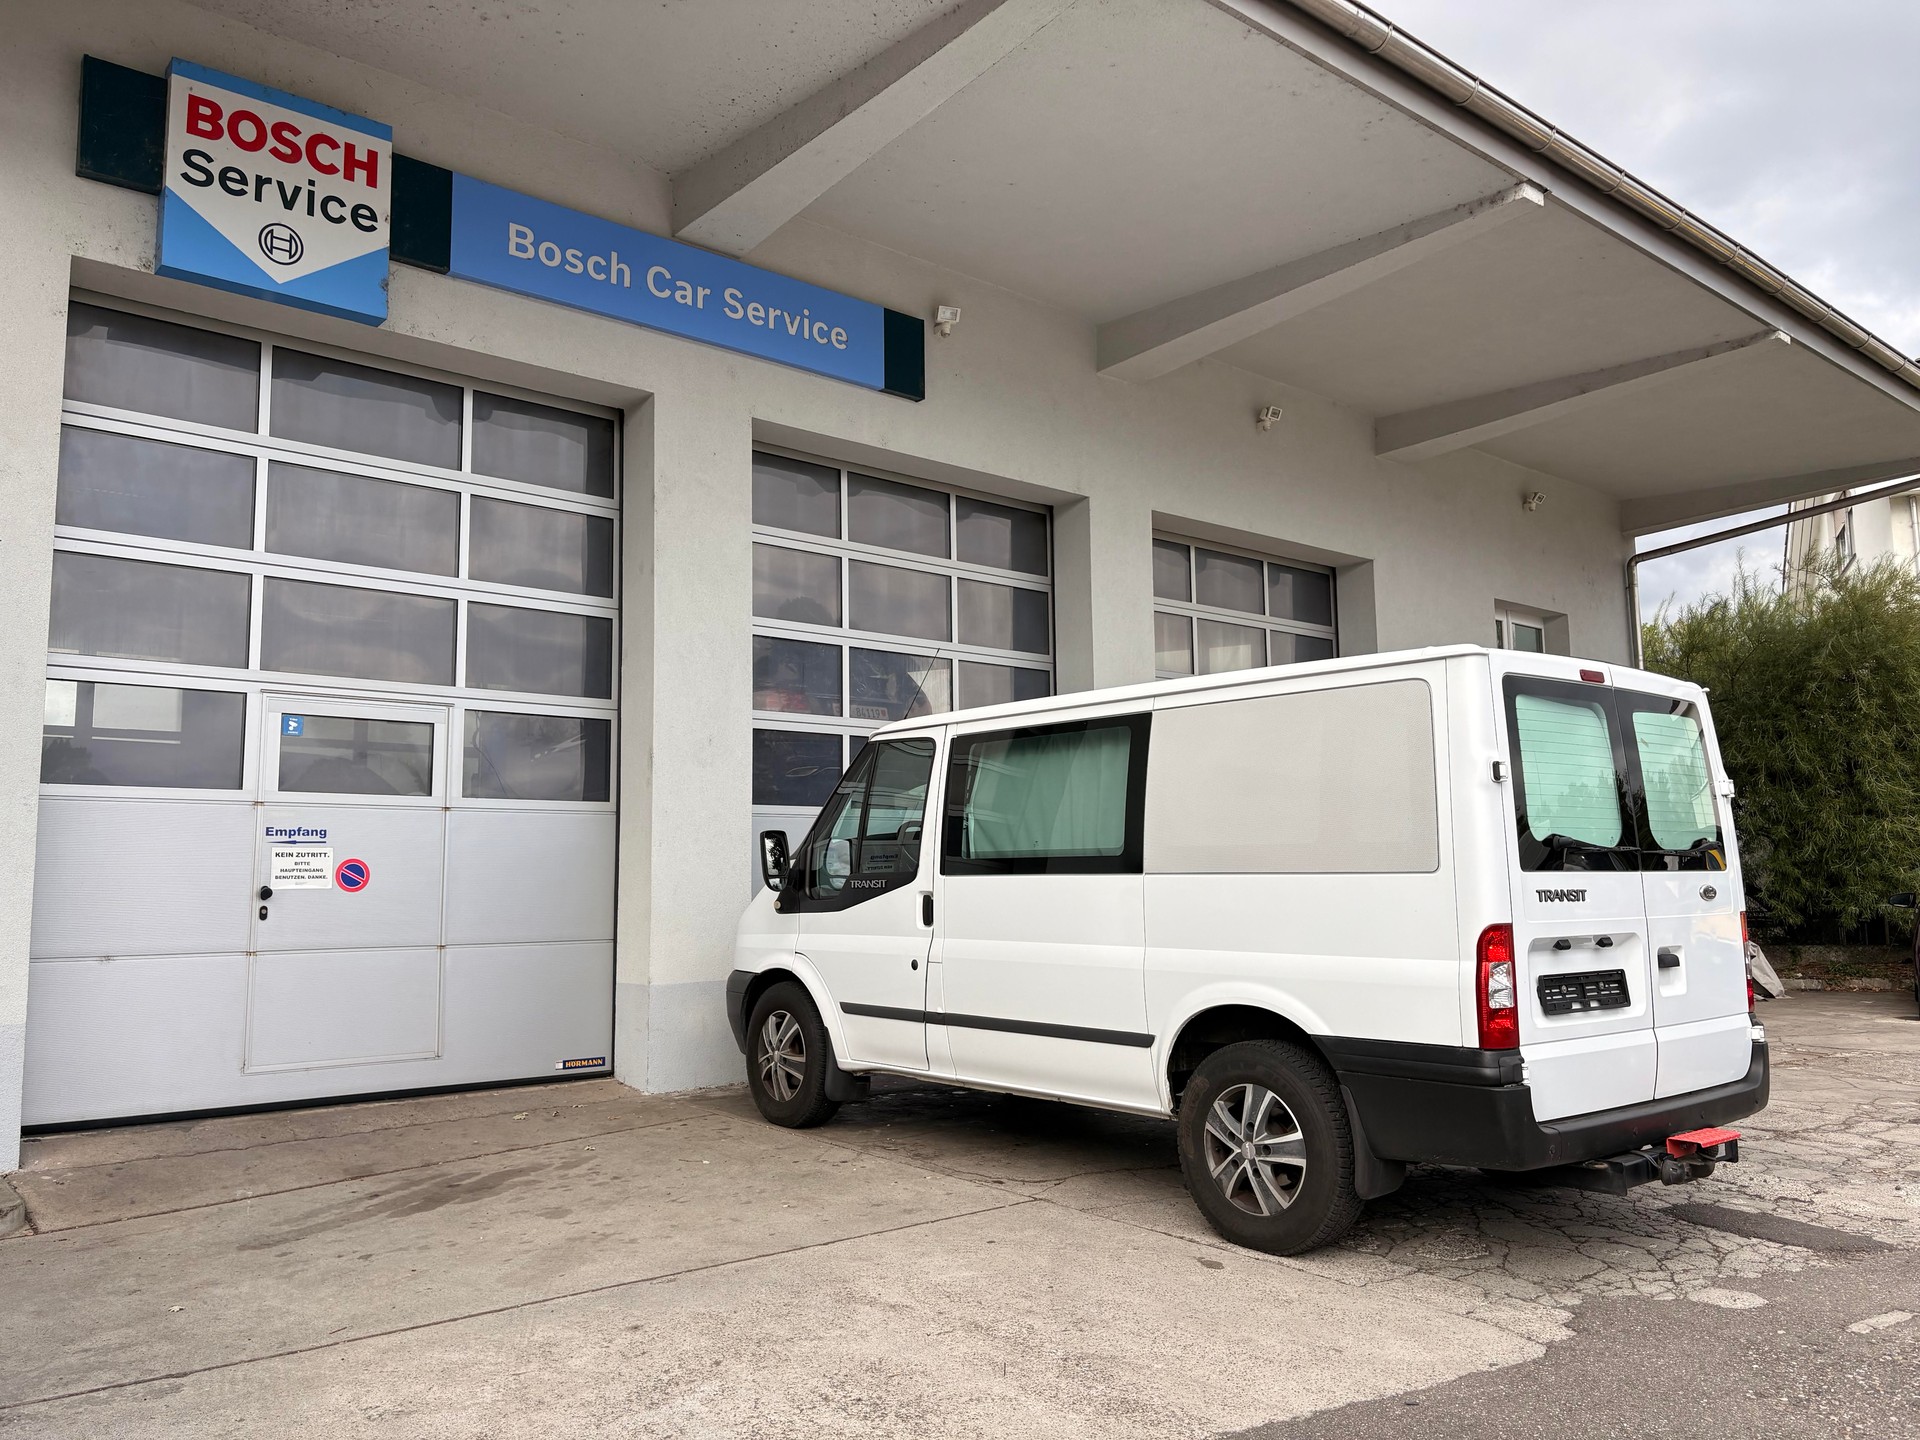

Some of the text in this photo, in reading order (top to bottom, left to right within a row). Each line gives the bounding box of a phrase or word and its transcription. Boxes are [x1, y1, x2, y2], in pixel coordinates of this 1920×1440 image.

[185, 93, 379, 189] BOSCH
[180, 148, 379, 233] Service
[508, 222, 849, 350] Bosch Car Service
[265, 827, 327, 839] Empfang
[849, 879, 887, 889] TRANSIT
[1536, 889, 1587, 902] TRANSIT
